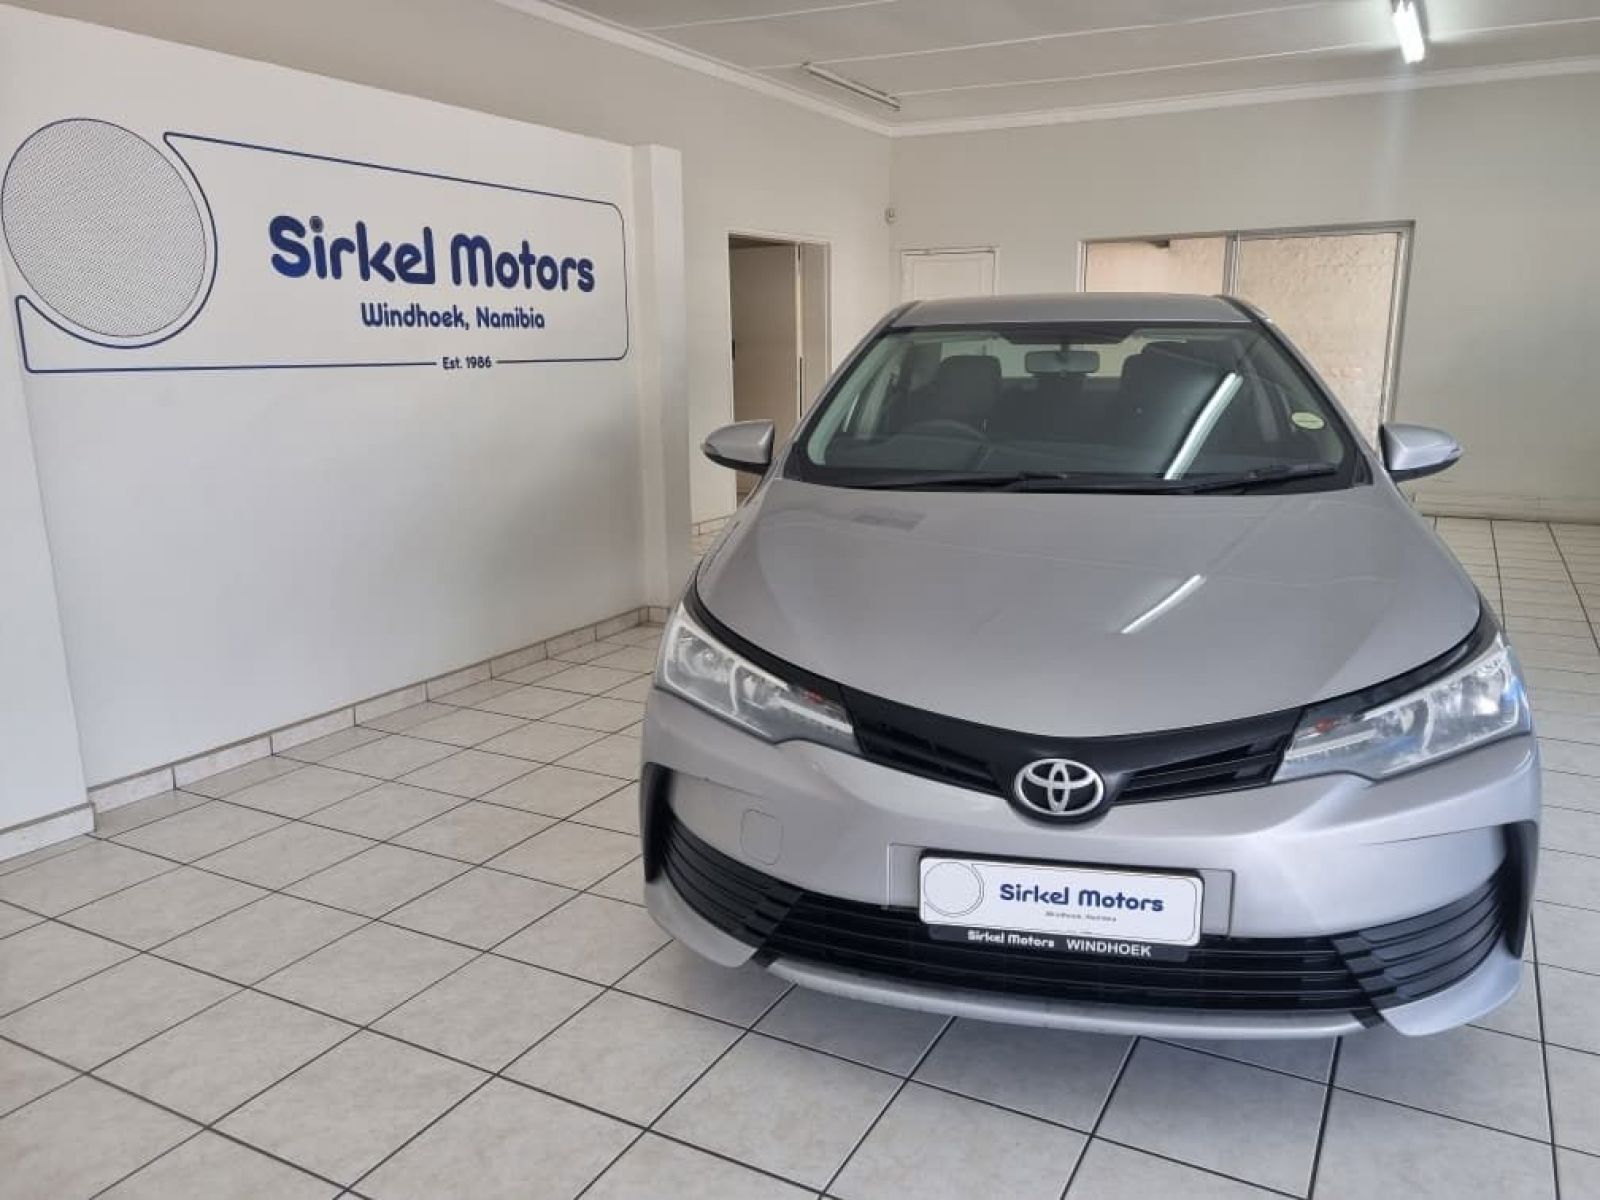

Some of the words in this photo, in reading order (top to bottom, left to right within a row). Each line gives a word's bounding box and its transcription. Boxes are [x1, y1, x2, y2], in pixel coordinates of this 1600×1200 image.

[269, 214, 436, 285] Sirkel
[450, 233, 595, 293] Motors
[360, 302, 470, 331] Windhoek,
[475, 306, 546, 330] Namibia
[442, 356, 462, 370] Est.
[466, 355, 492, 370] 1986
[999, 883, 1069, 905] Sirkel
[1078, 889, 1165, 912] Motors
[967, 930, 1005, 944] Sirkel
[1008, 934, 1055, 948] Motors
[1066, 938, 1152, 957] WINDHOEK
